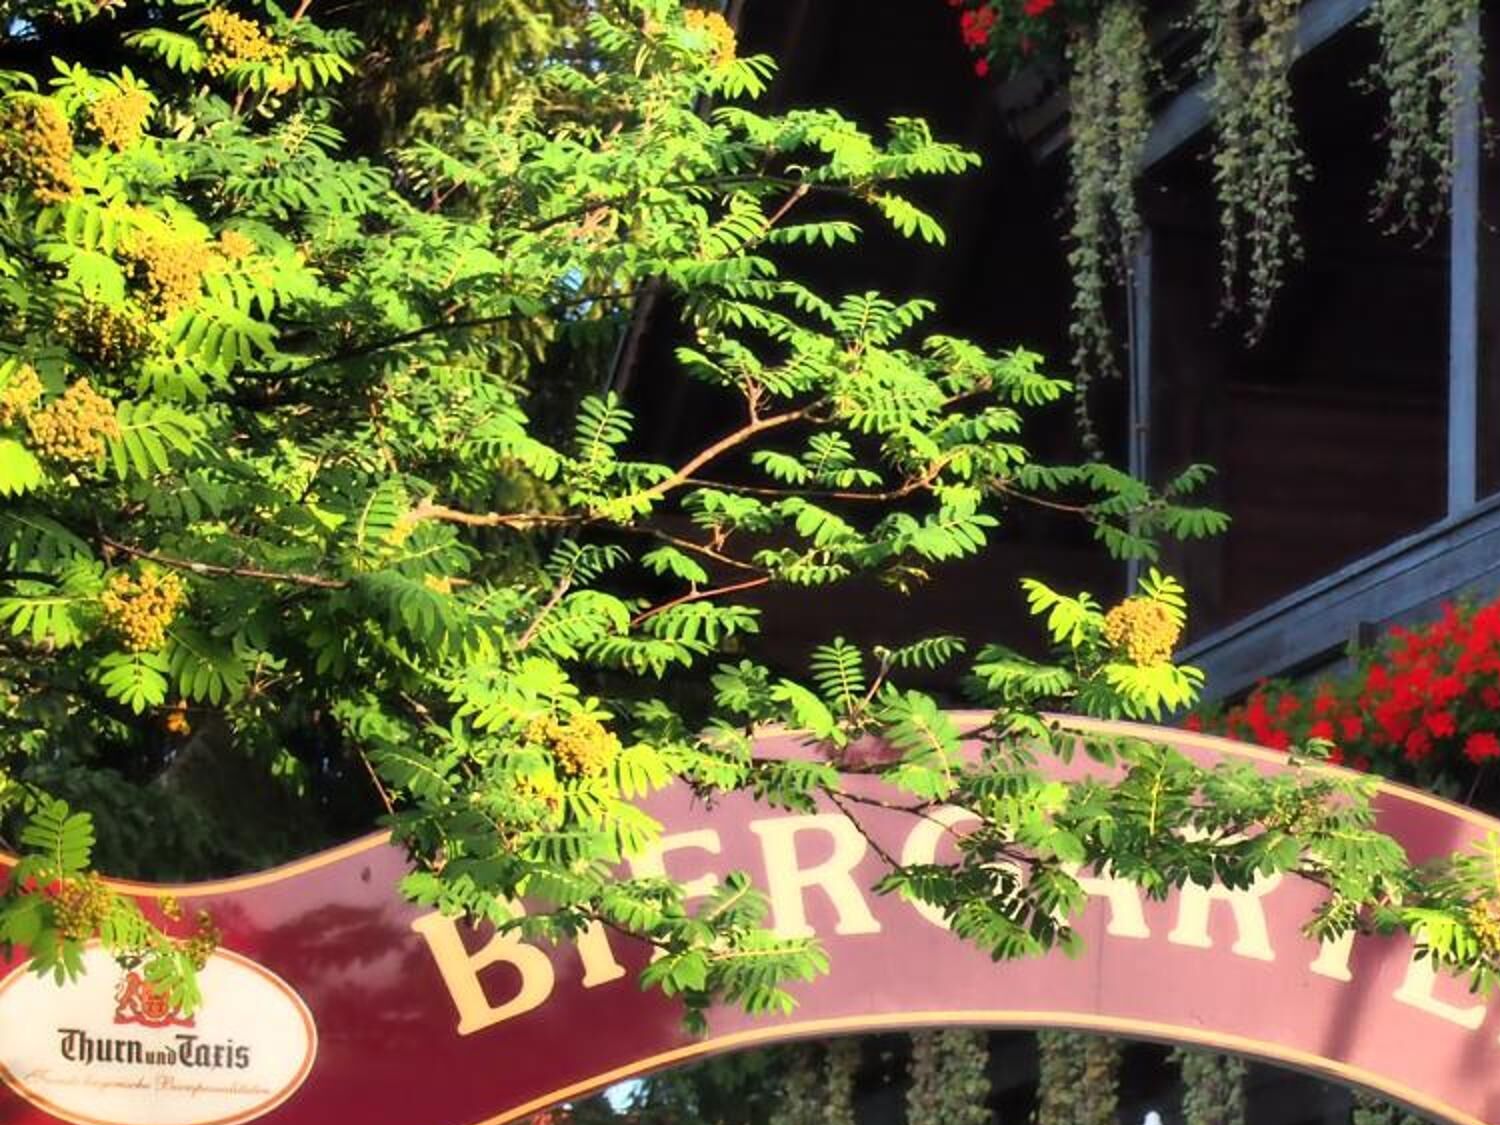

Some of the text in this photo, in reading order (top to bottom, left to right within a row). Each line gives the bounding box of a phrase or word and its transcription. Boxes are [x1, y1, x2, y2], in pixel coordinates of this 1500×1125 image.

[57, 1028, 250, 1070] Thurn und Taxis
